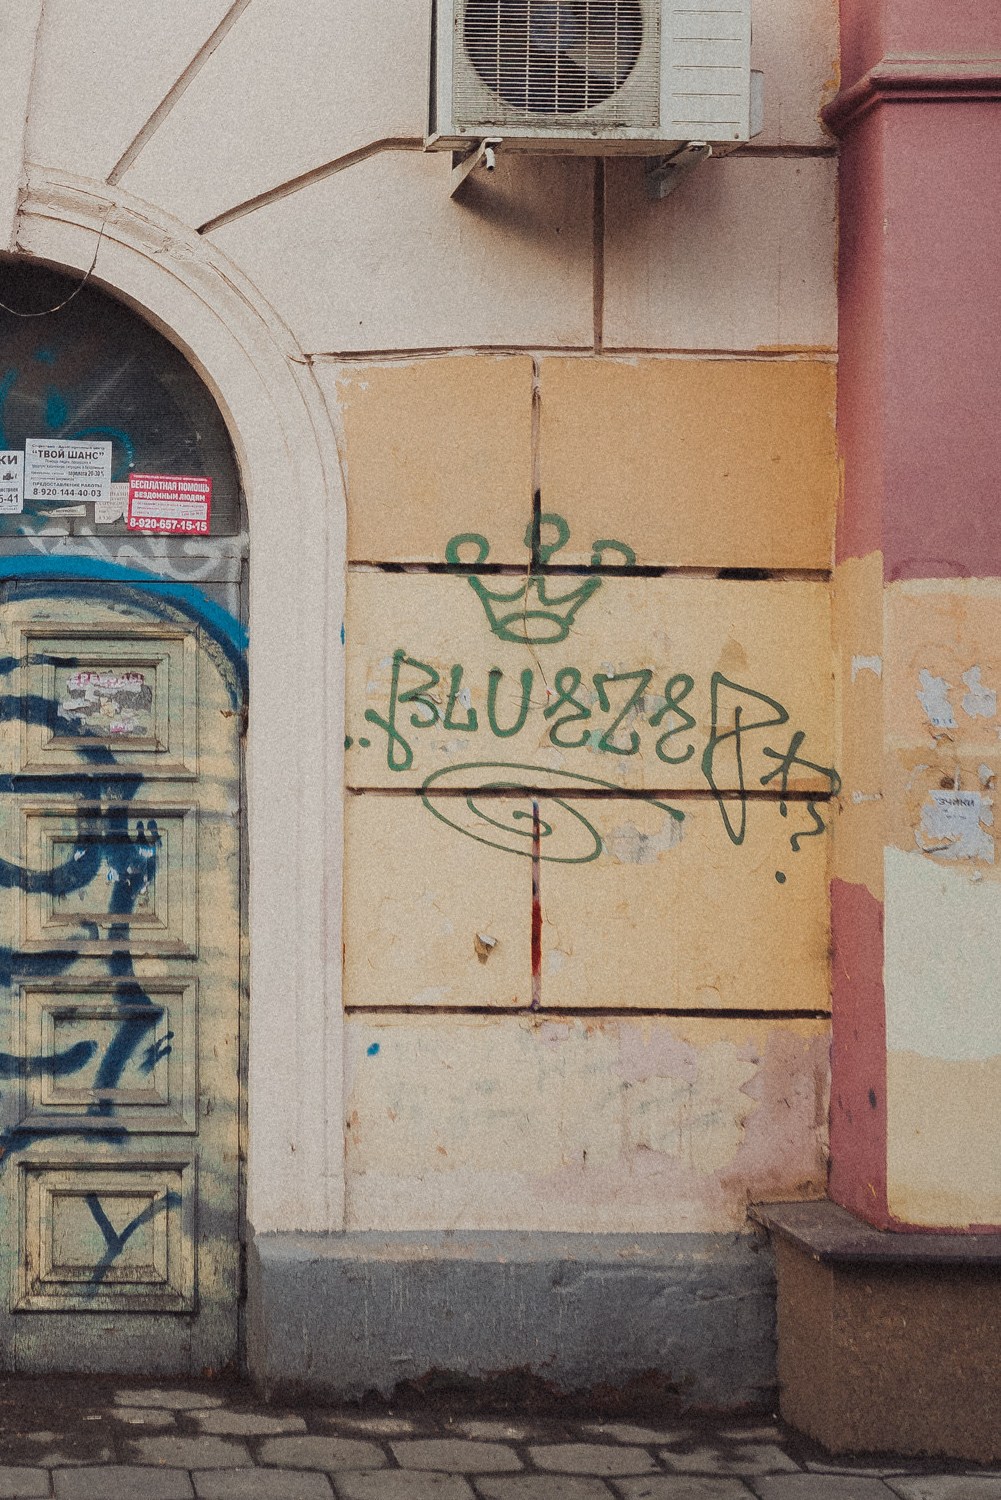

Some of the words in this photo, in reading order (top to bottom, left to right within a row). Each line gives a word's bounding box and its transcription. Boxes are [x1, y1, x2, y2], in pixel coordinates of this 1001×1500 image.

[130, 479, 177, 491] БЕСПЛАТНАЯ
[178, 482, 210, 493] ПОМОЩЬ
[32, 488, 102, 498] 8-920-144-40-03
[134, 491, 178, 500] БЕЗДОМНЫМ
[179, 493, 206, 502] ЛЮДЯМ
[129, 518, 208, 532] 8-920-657-15-15
